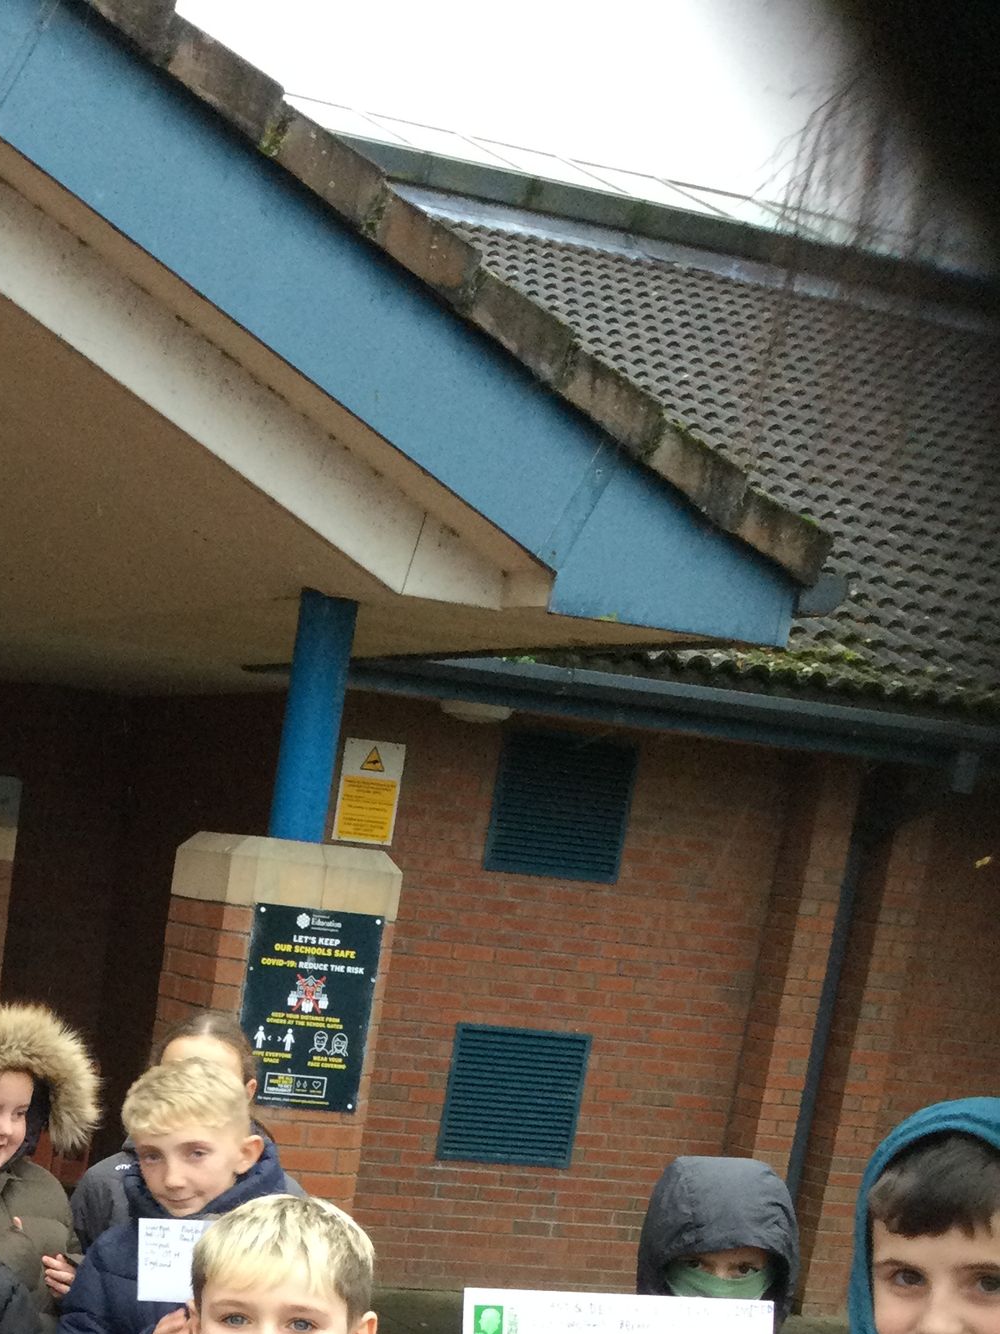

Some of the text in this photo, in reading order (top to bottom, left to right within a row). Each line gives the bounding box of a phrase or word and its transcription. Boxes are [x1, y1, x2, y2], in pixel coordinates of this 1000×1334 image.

[293, 935, 341, 946] LET'S KEEP
[274, 943, 356, 959] OUR SCHOOLS SAFE
[261, 958, 365, 975] COVID-19: REDUCE THE RISK
